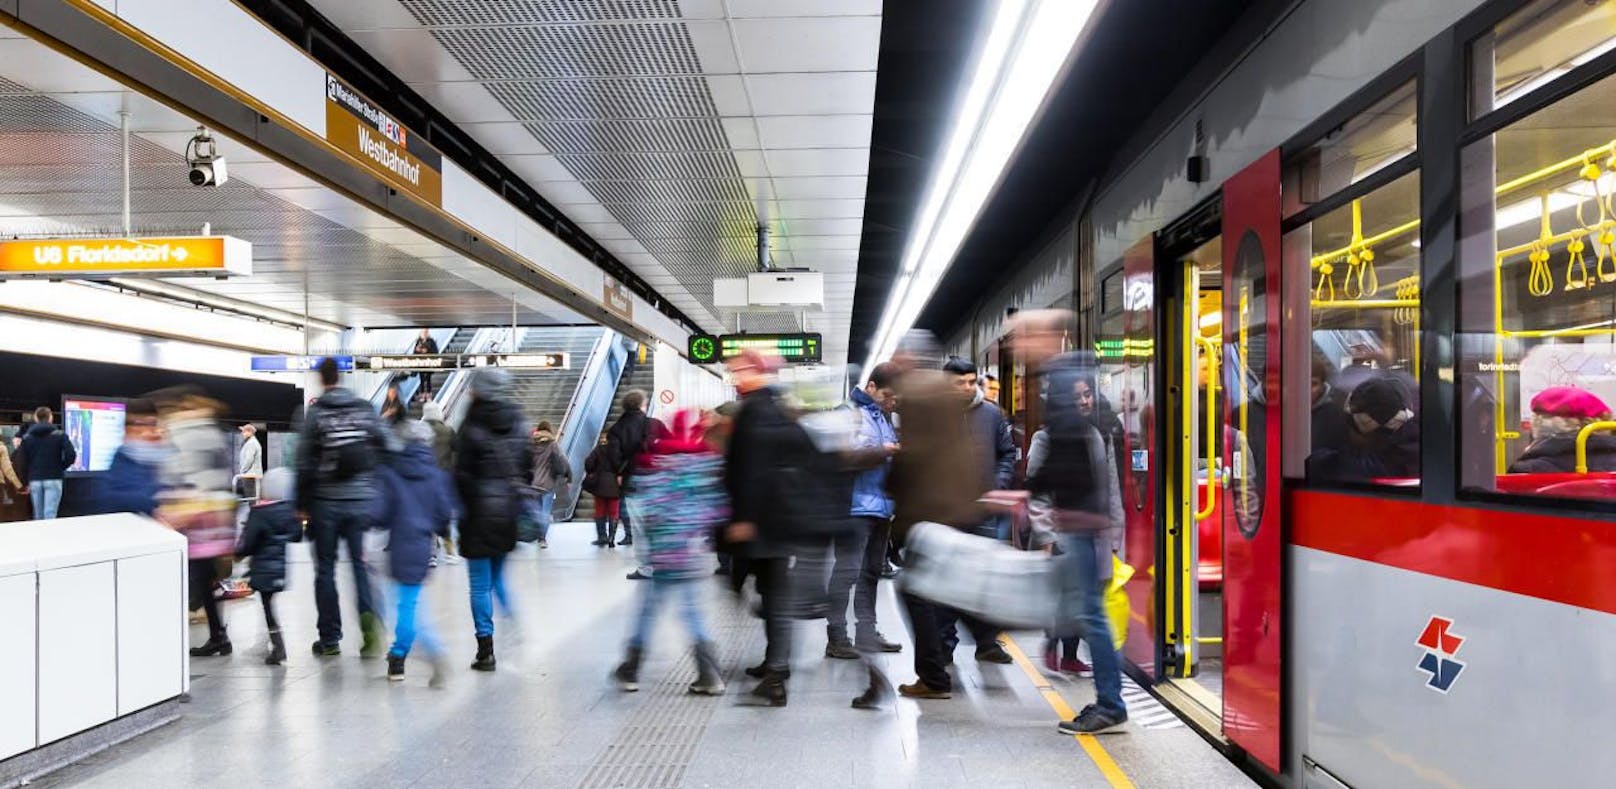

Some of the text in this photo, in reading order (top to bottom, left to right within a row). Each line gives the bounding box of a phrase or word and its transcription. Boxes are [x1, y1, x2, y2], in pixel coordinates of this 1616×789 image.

[358, 124, 420, 186] Westbahnhof
[34, 243, 170, 265] U6 Floridsdorf
[383, 357, 442, 367] Westbahnhof
